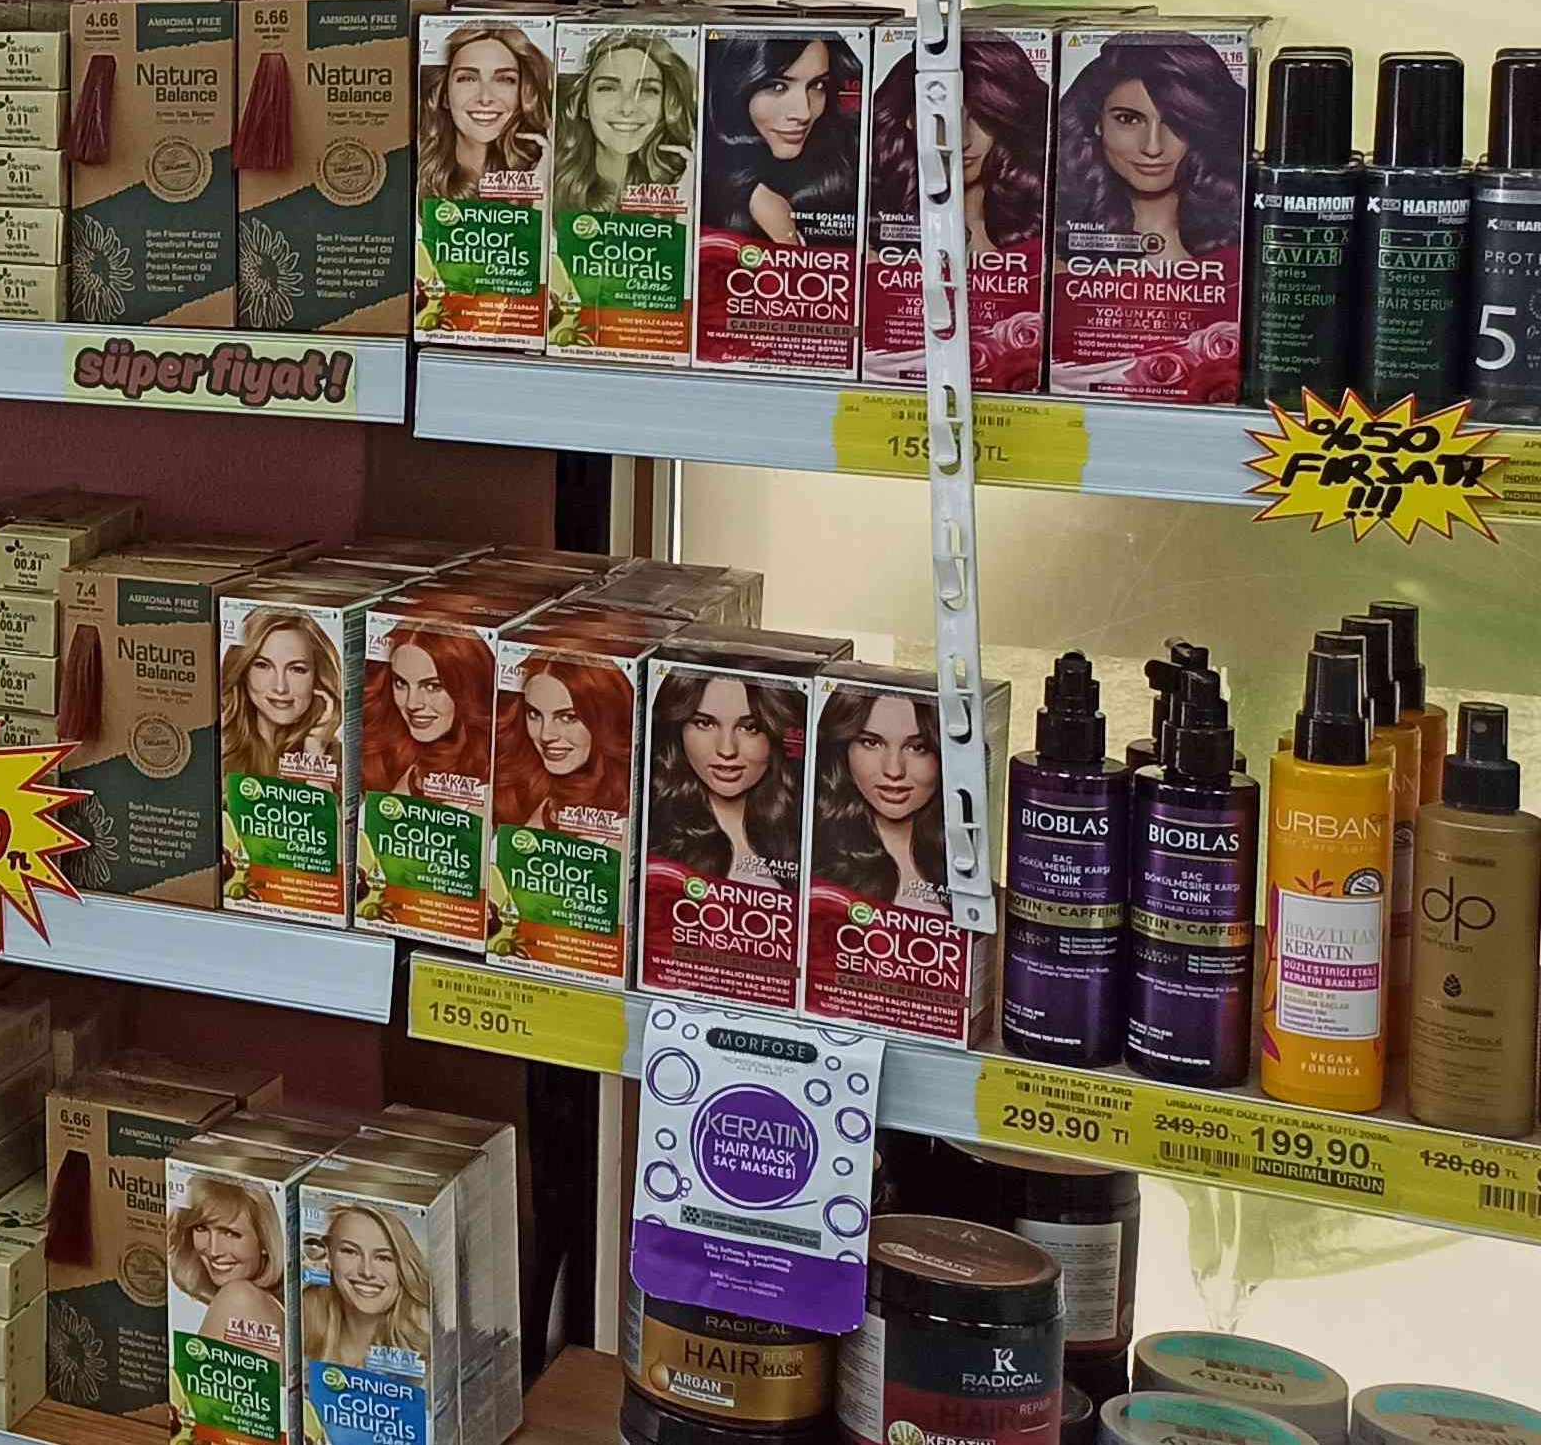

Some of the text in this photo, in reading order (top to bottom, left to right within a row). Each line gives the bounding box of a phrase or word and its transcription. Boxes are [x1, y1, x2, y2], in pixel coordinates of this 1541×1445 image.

[85, 13, 118, 27] 4.66
[148, 16, 222, 27] AMMONIA FREE
[254, 10, 289, 25] 6.66
[136, 63, 217, 87] Natura
[307, 63, 392, 86] Natura
[155, 87, 217, 104] Balance
[327, 87, 392, 104] Balance
[1284, 195, 1355, 213] HARMONY
[573, 216, 673, 240] GARNIER
[1067, 256, 1224, 281] GARNIER
[726, 271, 850, 302] COLOR
[1065, 280, 1226, 304] ÇARPICI RENKLER
[75, 338, 203, 397] süper
[1308, 417, 1441, 453] %50
[75, 580, 98, 599] 7.4
[252, 803, 312, 827] Color
[1021, 807, 1109, 835] BIOBLAS
[1275, 808, 1380, 840] URBAN
[1148, 822, 1240, 852] BIOBLAS
[6, 851, 31, 872] TL
[672, 899, 794, 944] COLOR
[1422, 876, 1495, 943] dp
[672, 927, 792, 960] SENSATION
[837, 925, 961, 972] COLOR
[1285, 938, 1353, 960] KERATIN
[836, 952, 960, 991] SENSATION
[429, 1002, 532, 1036] 159.90 TL
[717, 1031, 807, 1057] MORFOSE
[706, 1110, 812, 1151] KERATIN
[1002, 1104, 1100, 1143] 299.90
[713, 1139, 796, 1166] HAIR MASK
[1250, 1127, 1370, 1170] 199,90
[712, 1153, 796, 1181] SAÇ MASKESİ
[184, 1339, 270, 1373] GARNIER
[683, 1338, 760, 1377] HAIR
[672, 1371, 722, 1394] ARGAN
[962, 1372, 1042, 1388] RADICAL
